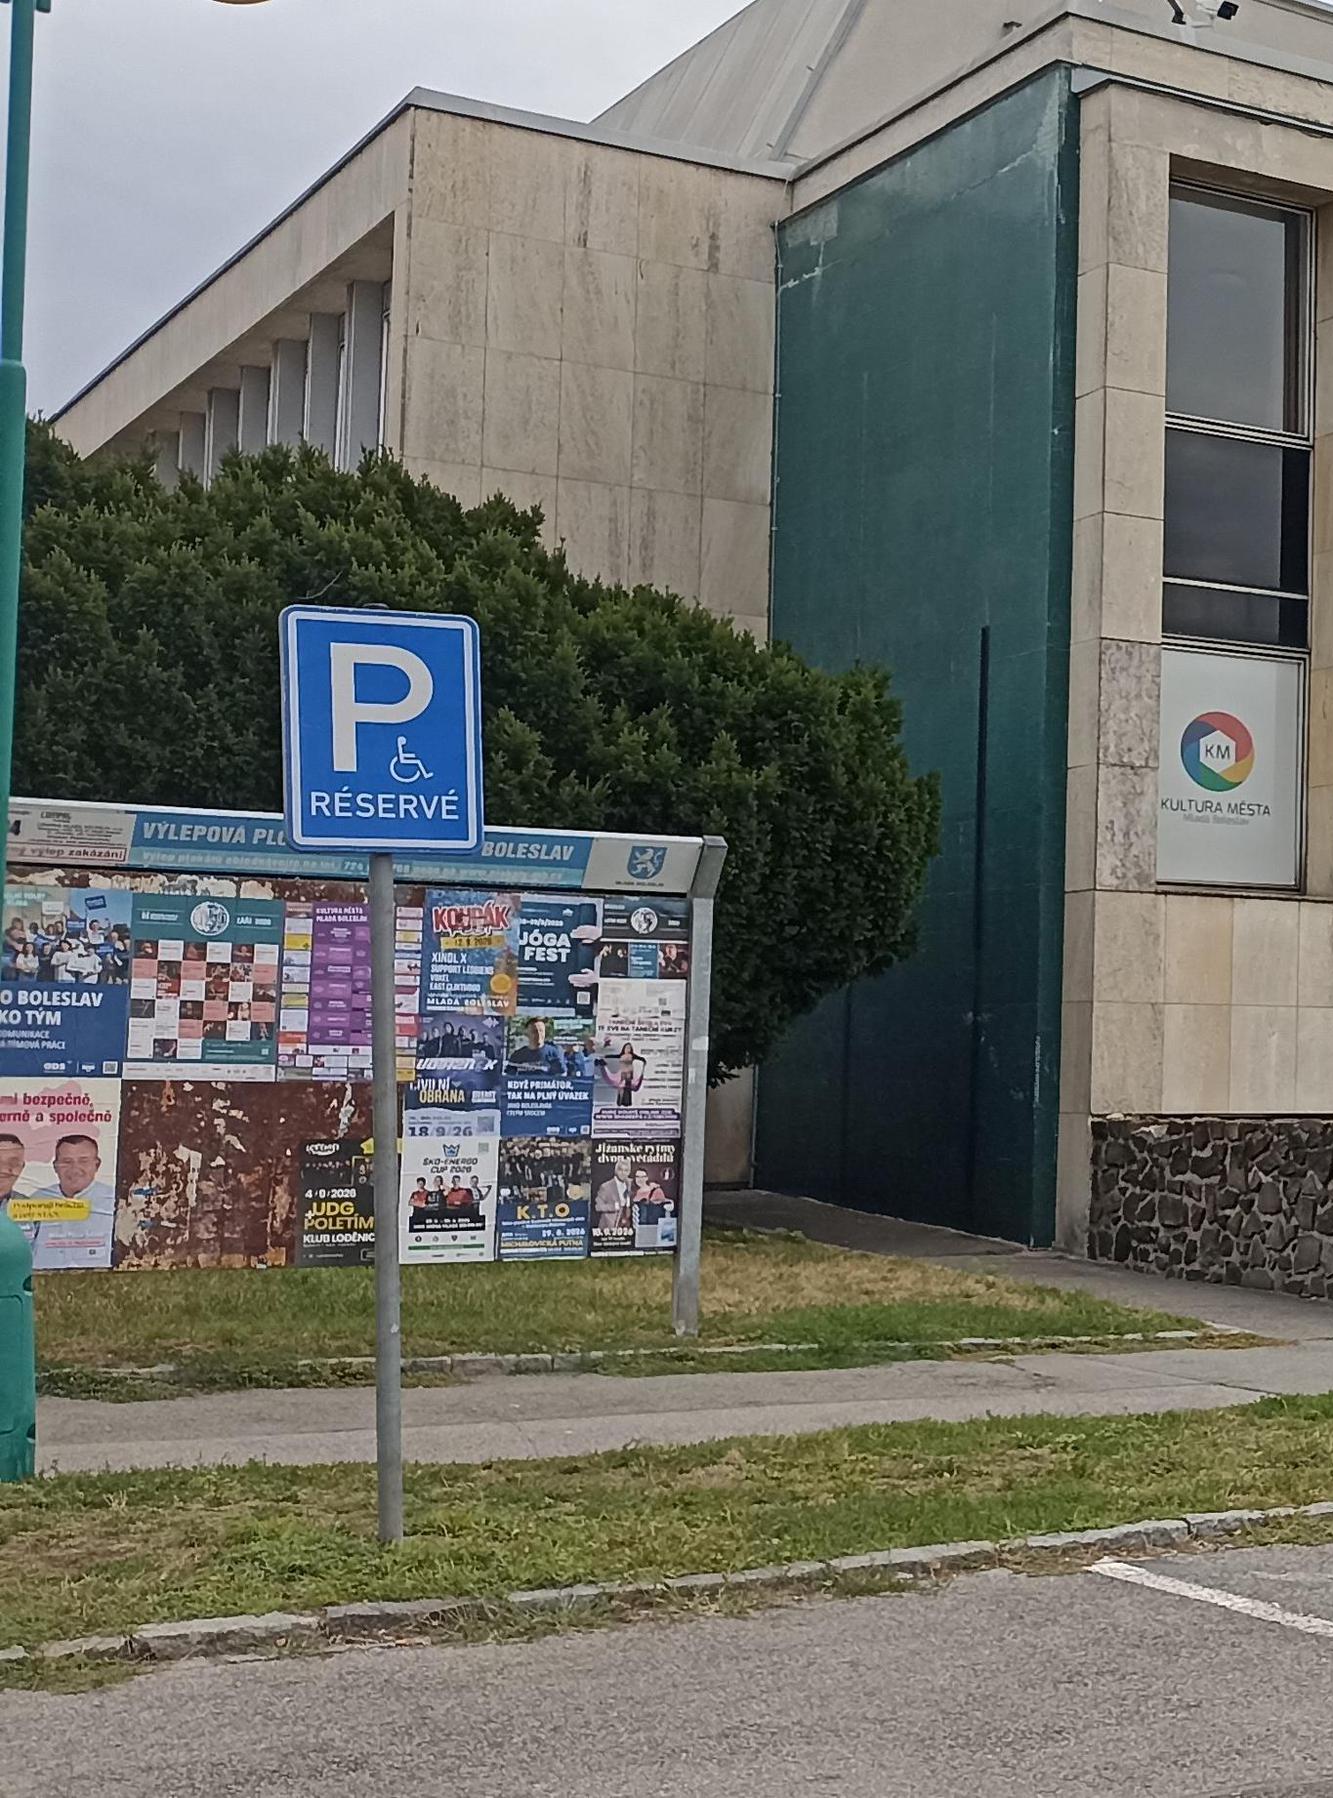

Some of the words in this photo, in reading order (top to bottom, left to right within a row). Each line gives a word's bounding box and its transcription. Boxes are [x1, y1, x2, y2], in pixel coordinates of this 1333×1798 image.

[330, 642, 434, 772] P
[1205, 744, 1230, 760] KM
[310, 786, 460, 820] RÉSERVÉ
[1161, 798, 1223, 814] KULTURA
[143, 820, 246, 844] VÝLEPOVÁ
[481, 841, 574, 861] BOLESLAV
[519, 929, 572, 948] JÓGA
[523, 946, 571, 963] FEST
[18, 990, 103, 1007] BOLESLAV
[25, 1007, 61, 1025] TÝM
[312, 1201, 355, 1216] UDG
[304, 1213, 375, 1230] POLETÍM
[303, 1233, 330, 1244] KLUB
